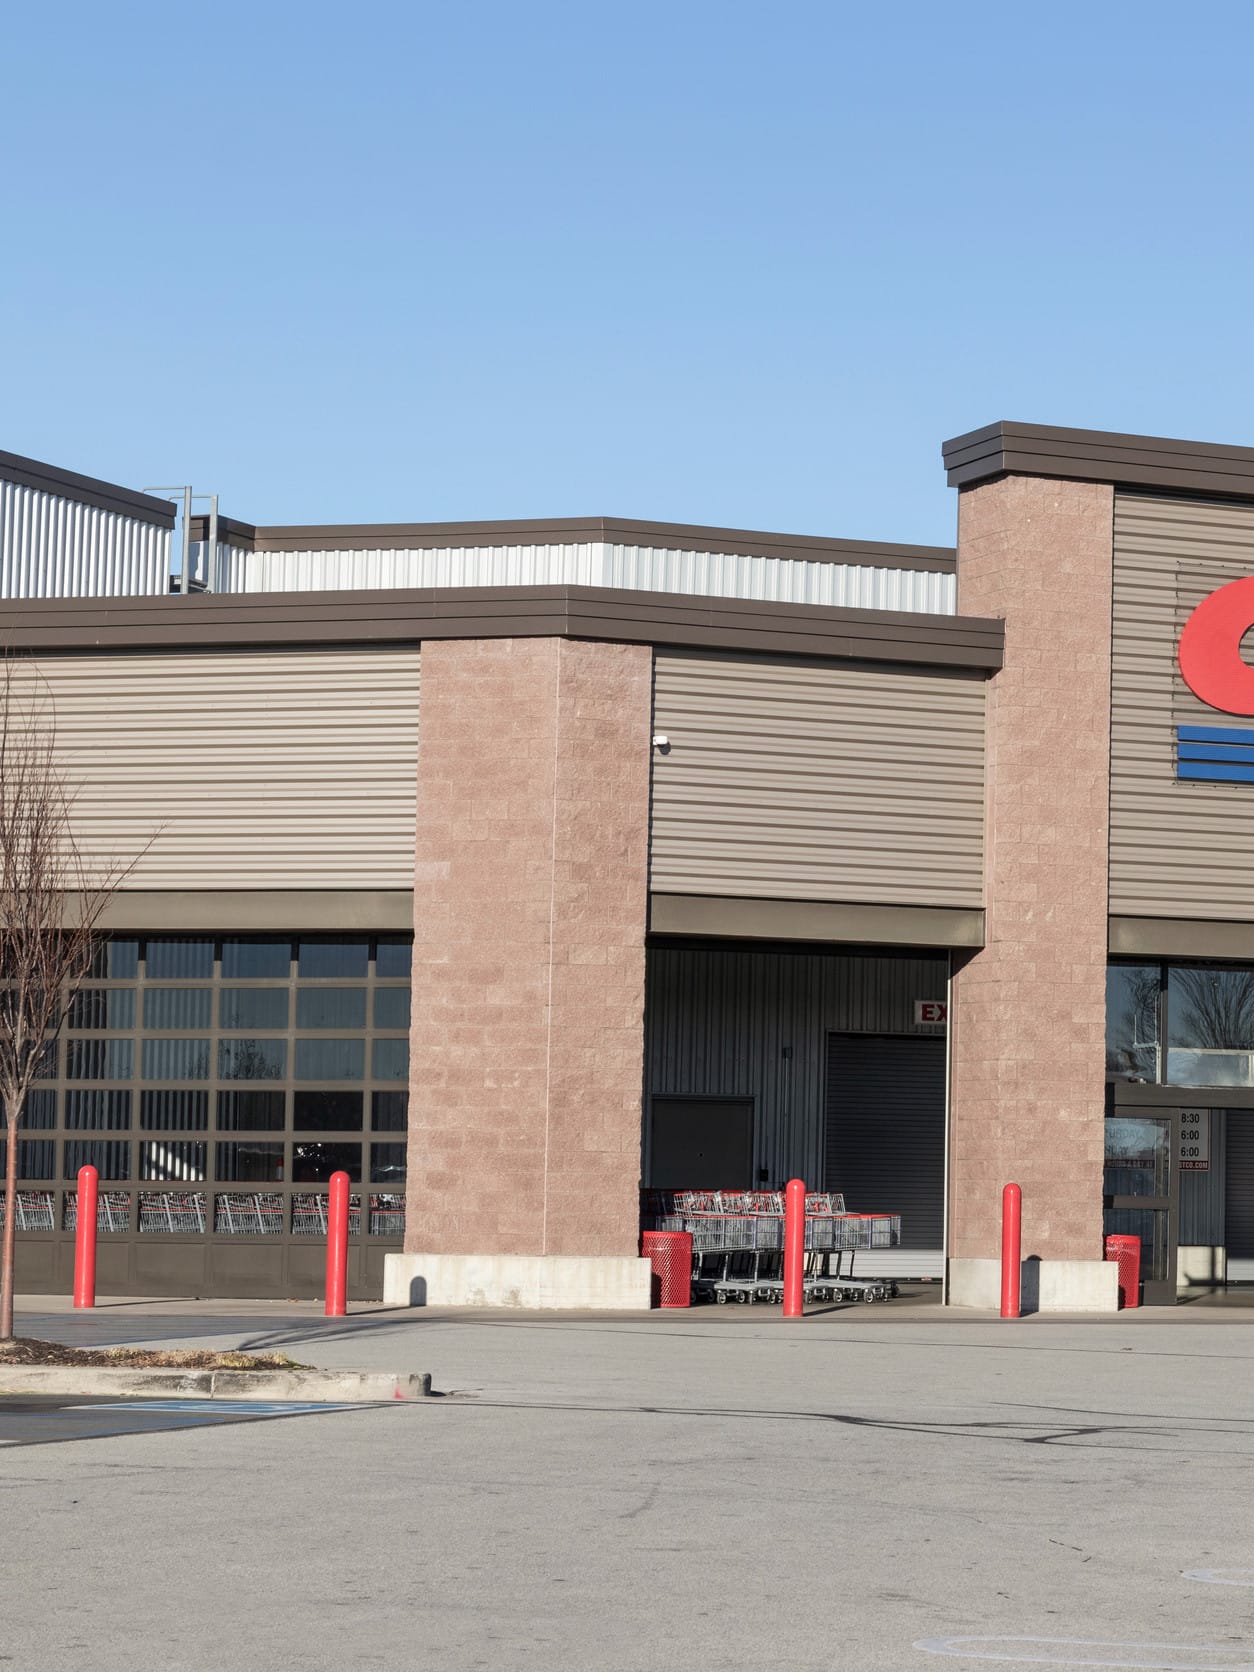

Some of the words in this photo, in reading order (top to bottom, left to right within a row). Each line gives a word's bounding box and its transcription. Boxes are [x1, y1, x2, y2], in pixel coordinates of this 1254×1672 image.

[1181, 1113, 1200, 1123] 8:30
[1181, 1130, 1200, 1140] 6:00
[1181, 1147, 1200, 1157] 6:00
